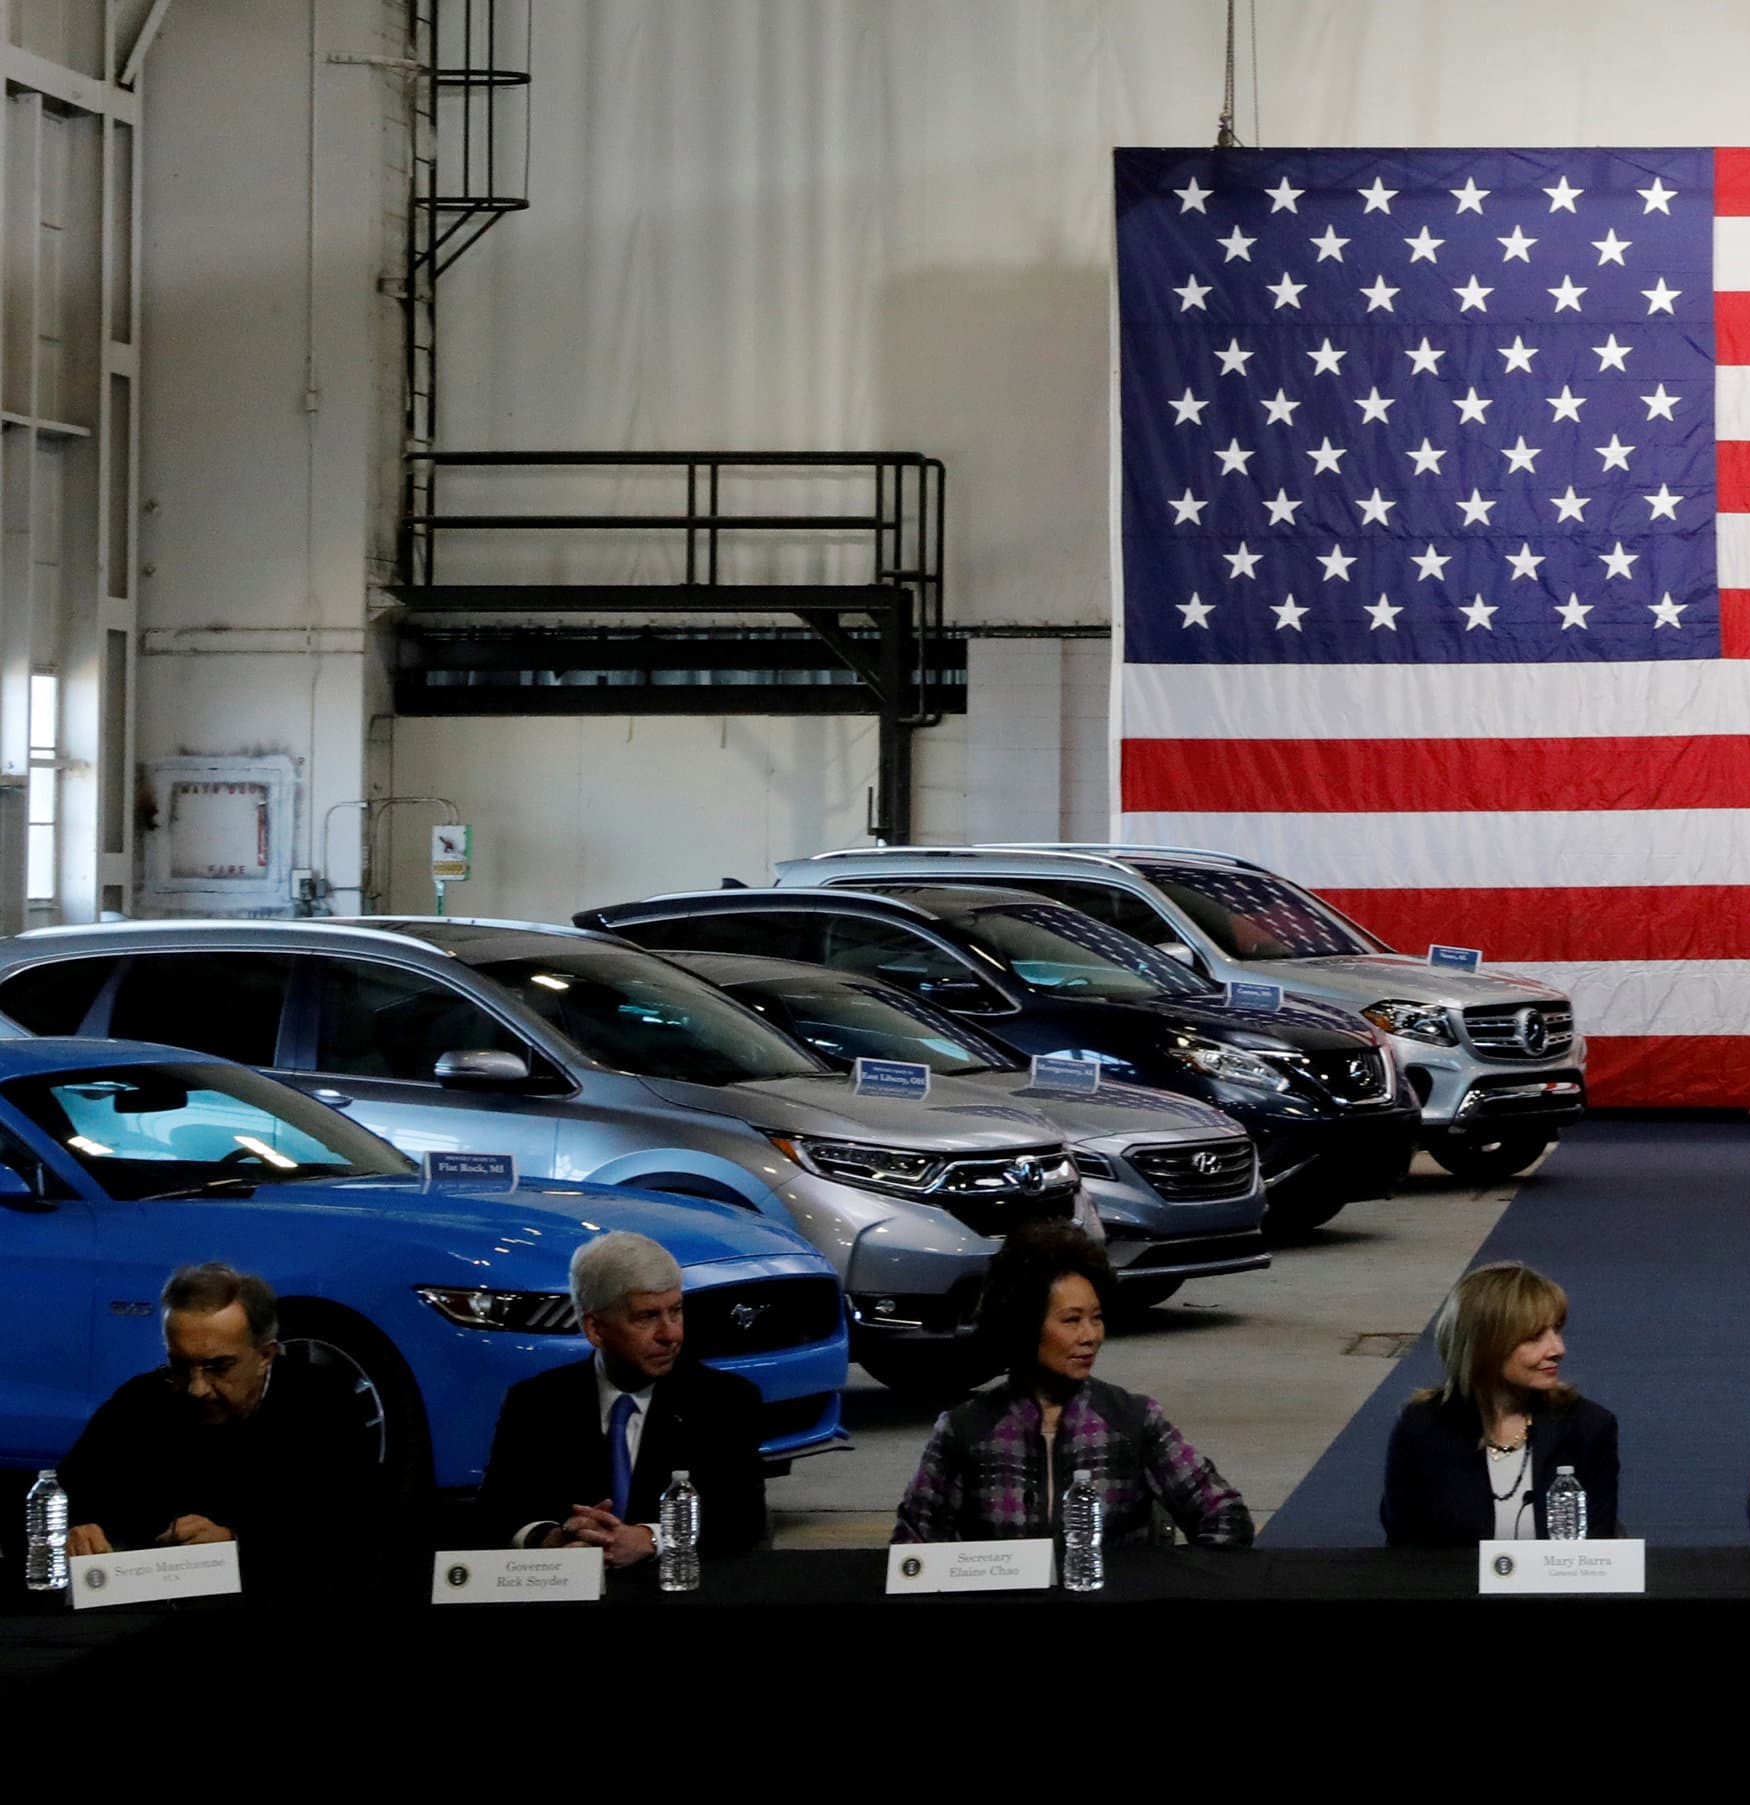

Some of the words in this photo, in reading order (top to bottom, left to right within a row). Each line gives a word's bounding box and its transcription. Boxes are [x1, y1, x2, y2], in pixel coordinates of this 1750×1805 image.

[439, 1162, 458, 1172] Flat
[957, 1553, 1013, 1564] Secretary
[1543, 1555, 1575, 1568] Mary
[1578, 1555, 1612, 1567] Barra
[506, 1561, 562, 1572] Governor
[950, 1566, 986, 1578] Elaine
[989, 1565, 1020, 1577] Chao
[496, 1576, 523, 1588] Rick
[526, 1575, 569, 1589] Snyder
